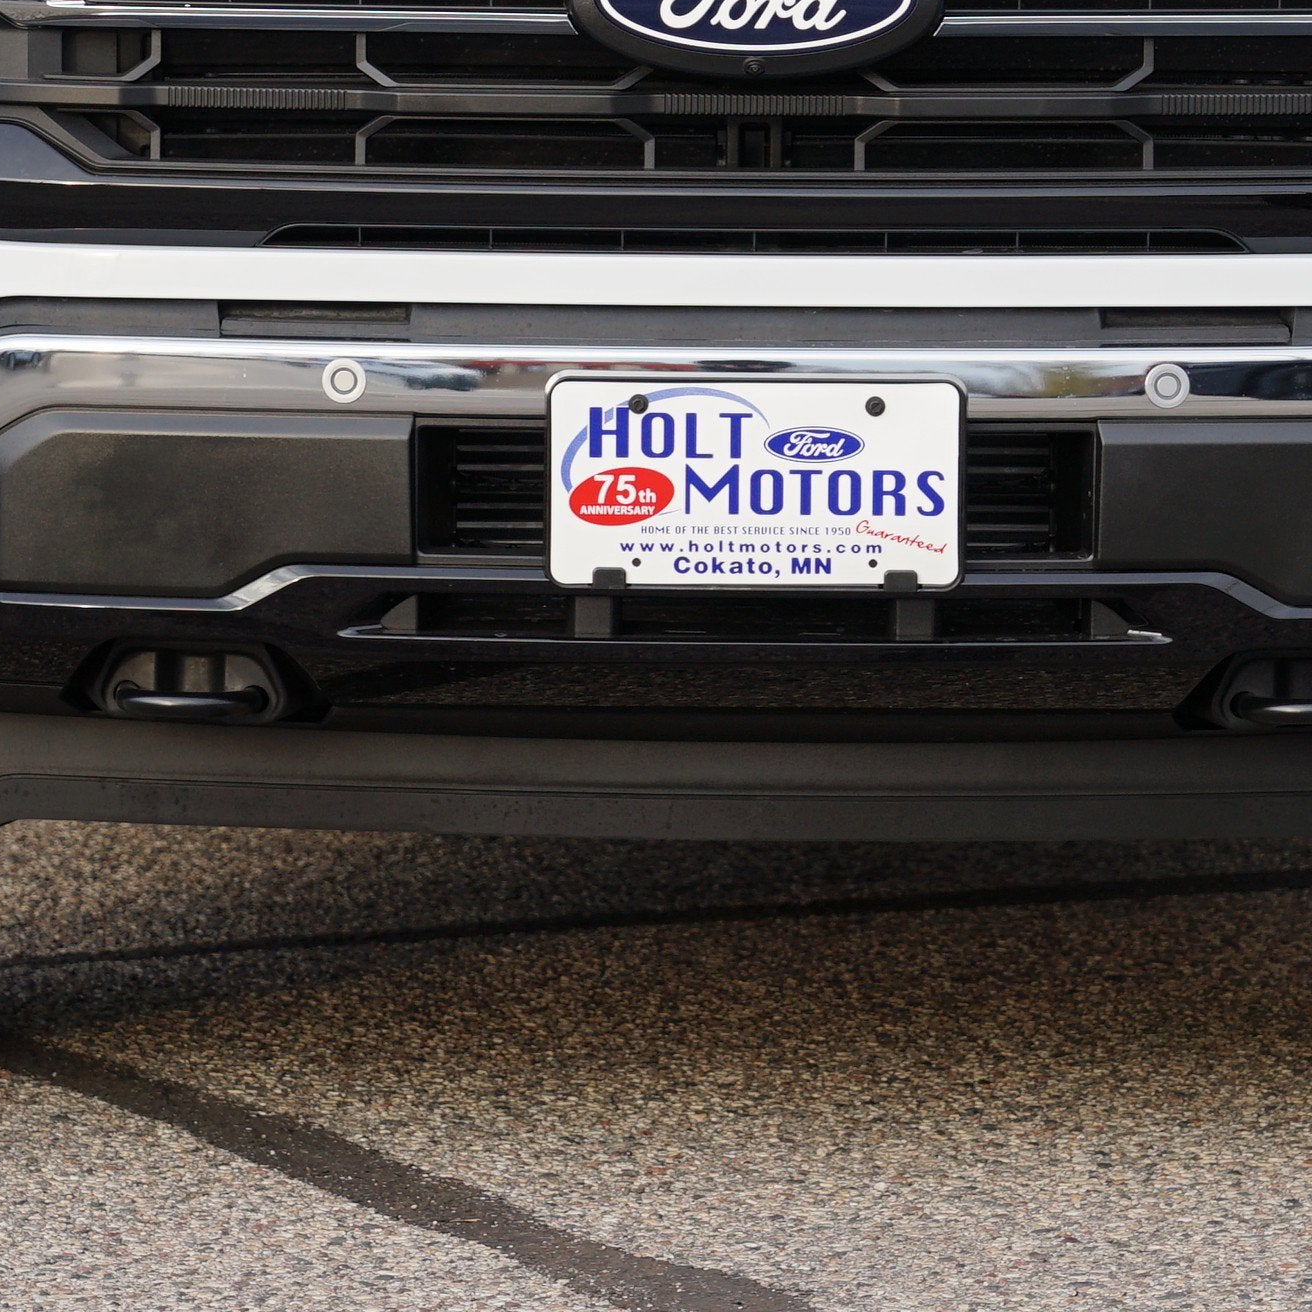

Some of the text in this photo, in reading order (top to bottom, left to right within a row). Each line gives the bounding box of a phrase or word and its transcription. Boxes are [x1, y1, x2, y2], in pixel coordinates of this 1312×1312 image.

[589, 406, 753, 459] HOLT
[783, 430, 846, 457] Ford
[593, 474, 657, 505] 75th
[685, 463, 945, 517] MOTORS
[579, 504, 656, 516] ANNIVERSARY
[640, 525, 851, 536] HOME OF THE BEST SERVICE SINCE 1950
[855, 519, 948, 555] Guaranteed
[620, 540, 882, 554] www.holtmotors.com
[673, 556, 832, 579] Cokato, MN
